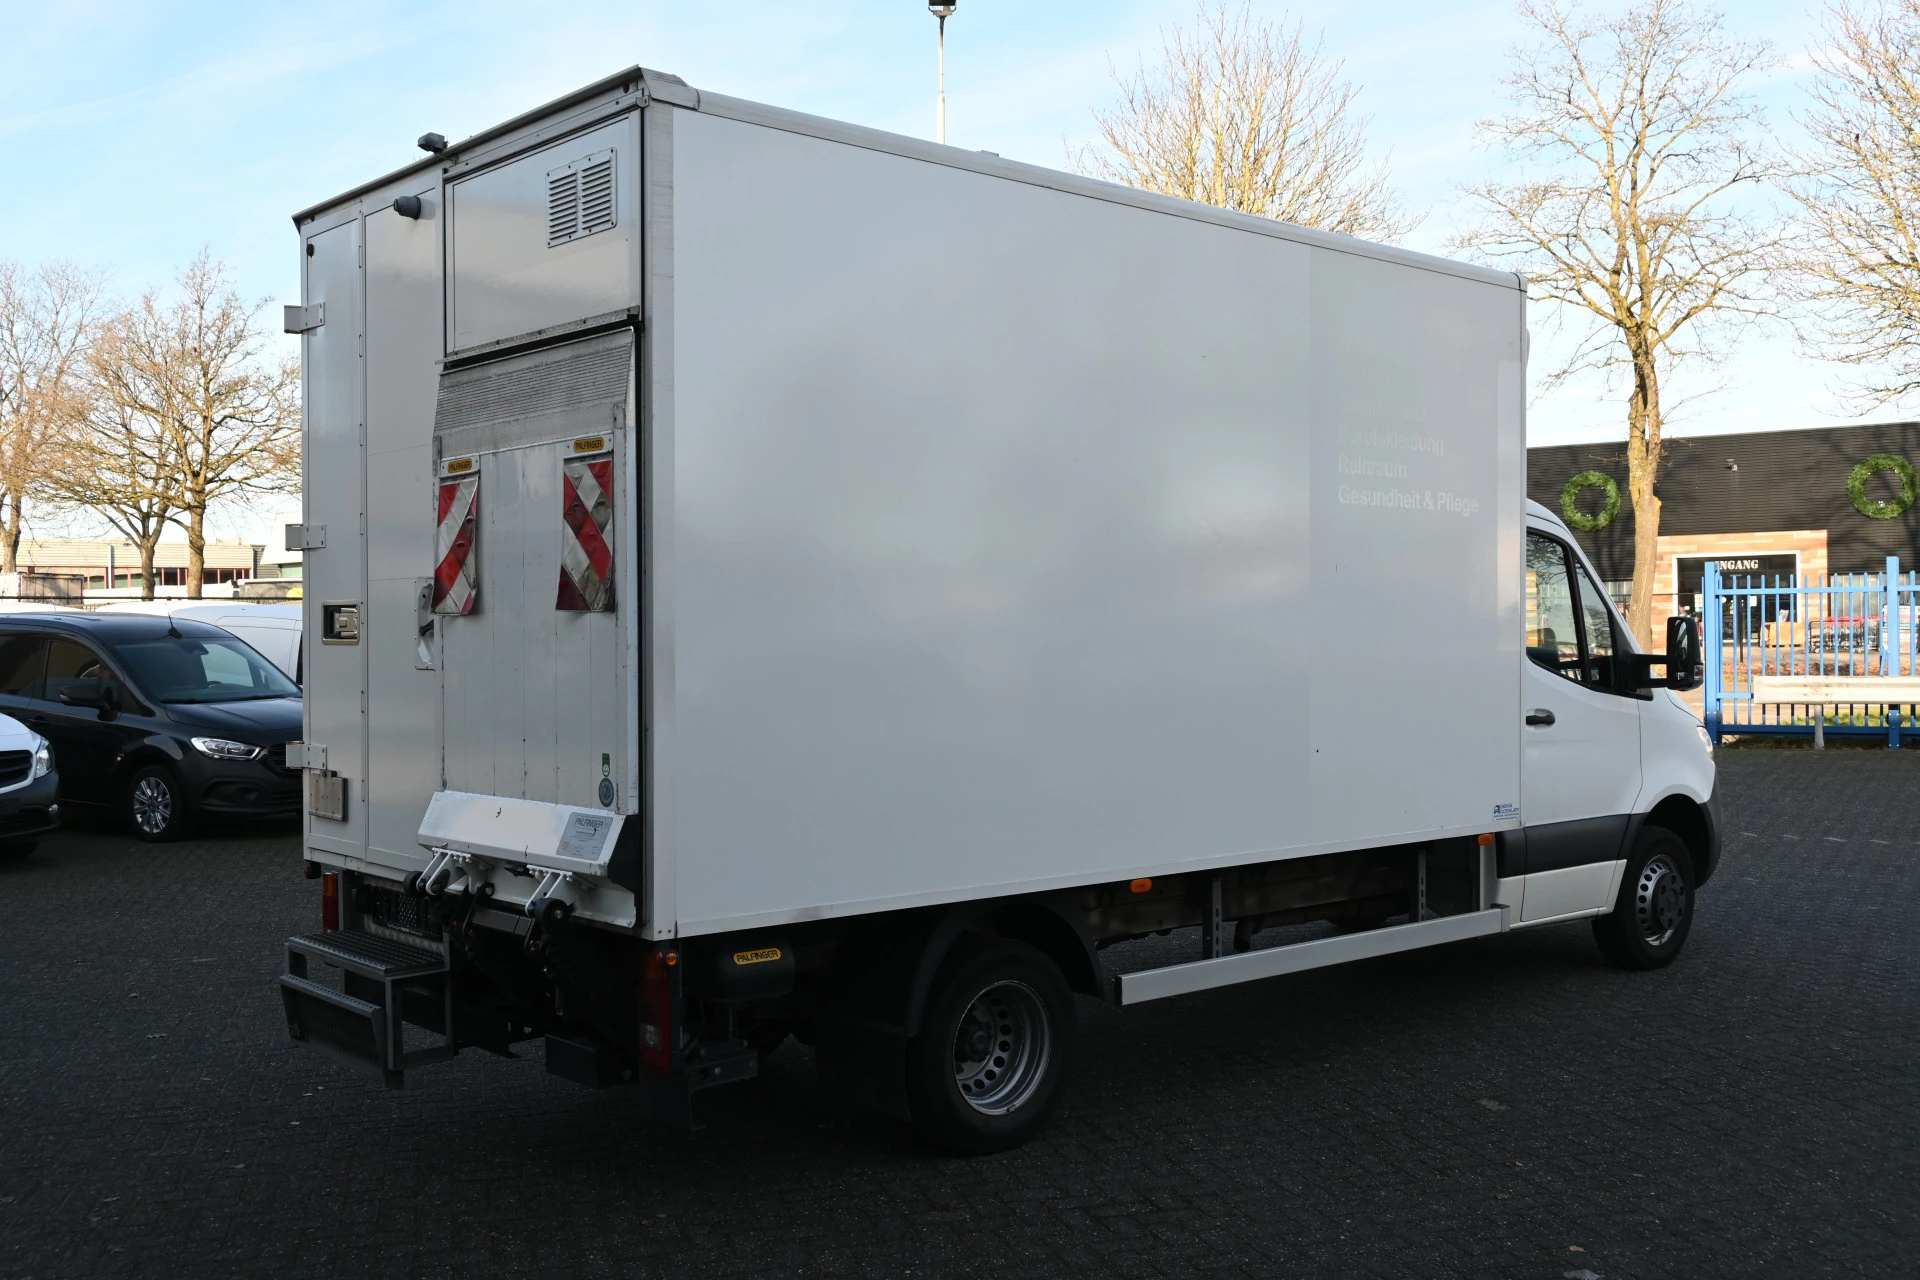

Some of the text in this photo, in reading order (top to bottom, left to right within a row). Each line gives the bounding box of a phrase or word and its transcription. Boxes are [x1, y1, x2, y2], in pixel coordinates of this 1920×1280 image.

[575, 439, 602, 451] PALFINGER
[1338, 453, 1407, 479] Reinraum
[1338, 484, 1479, 517] Gesundheit & Pflege
[574, 817, 604, 829] PALFINGER
[736, 949, 779, 963] PALFINGER
